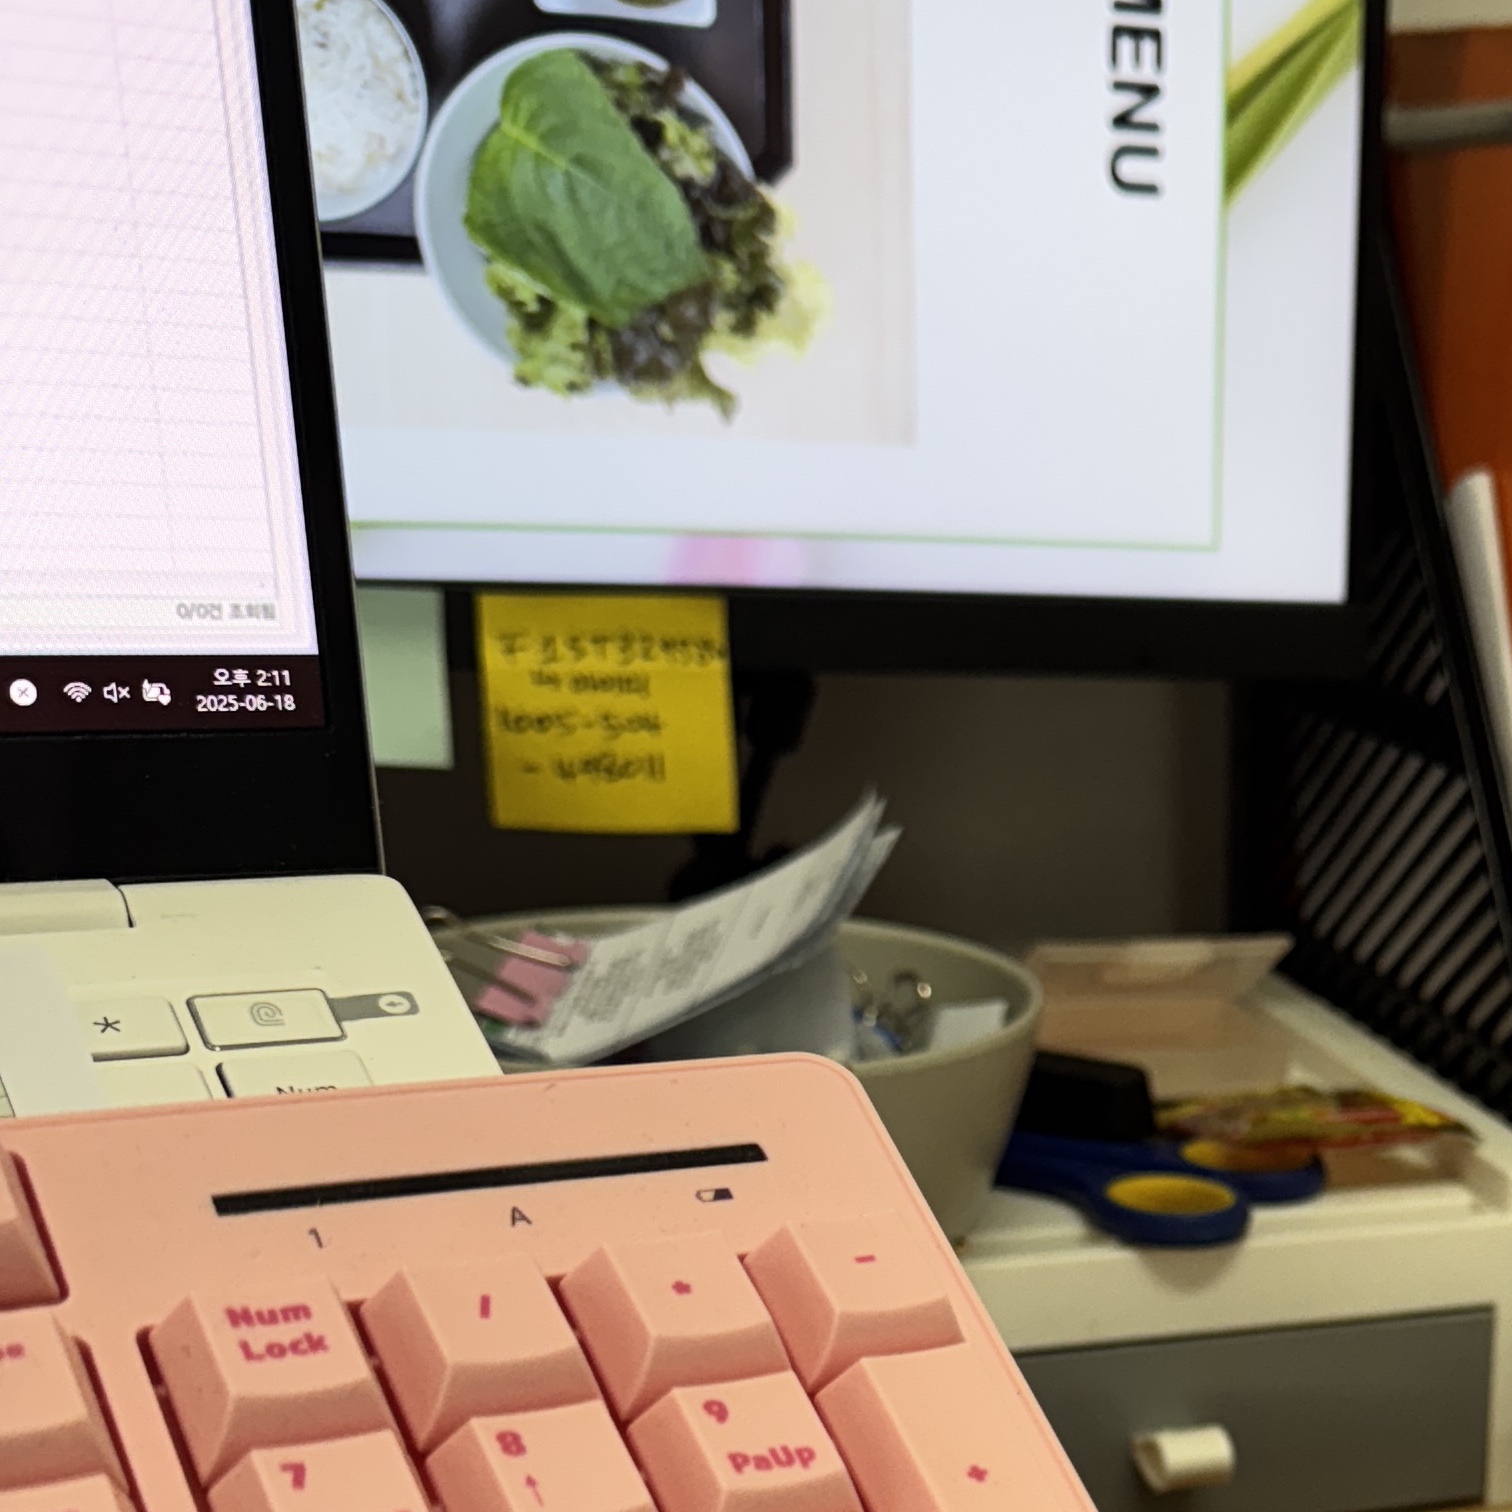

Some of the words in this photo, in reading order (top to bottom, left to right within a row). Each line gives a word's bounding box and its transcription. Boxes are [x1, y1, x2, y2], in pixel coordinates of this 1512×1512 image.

[1110, 0, 1162, 195] ENU
[213, 668, 251, 688] 오후
[256, 669, 291, 686] 2:11
[196, 694, 296, 712] 2025-06-18
[225, 1304, 312, 1329] Num
[239, 1332, 328, 1362] Lock
[702, 1399, 729, 1424] 9
[495, 1430, 527, 1457] 8
[280, 1462, 307, 1490] 7
